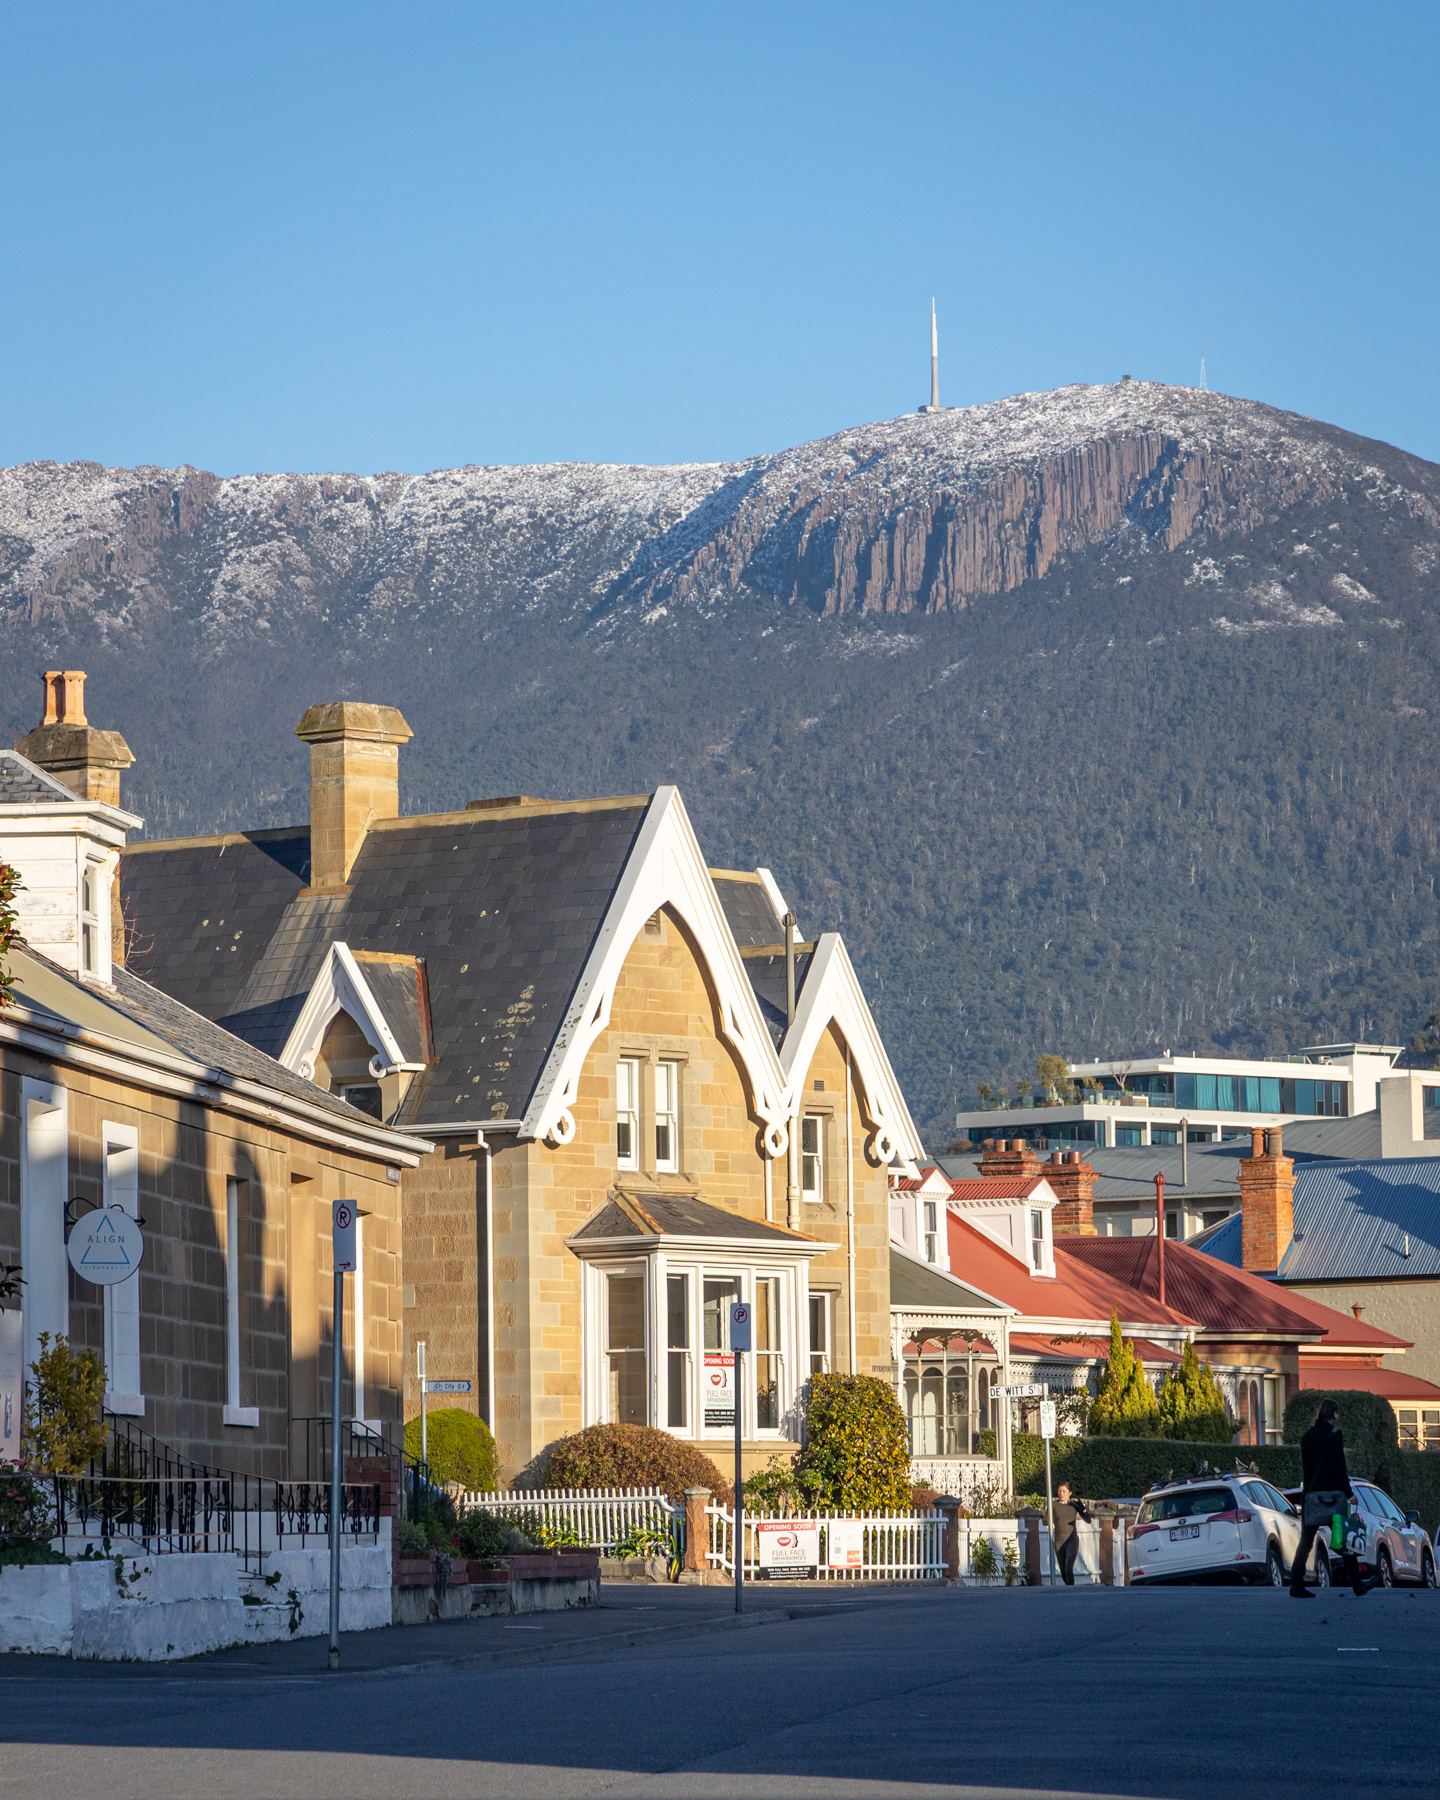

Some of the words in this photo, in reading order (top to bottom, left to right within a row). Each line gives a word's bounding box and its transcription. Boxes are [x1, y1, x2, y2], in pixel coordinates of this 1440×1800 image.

[87, 1235, 125, 1243] ALIGN
[706, 1389, 719, 1397] FULL
[720, 1389, 733, 1397] FACE
[990, 1387, 1001, 1397] DE
[1005, 1385, 1024, 1396] WITT
[1042, 1404, 1053, 1414] 2P
[763, 1523, 791, 1531] OPENING
